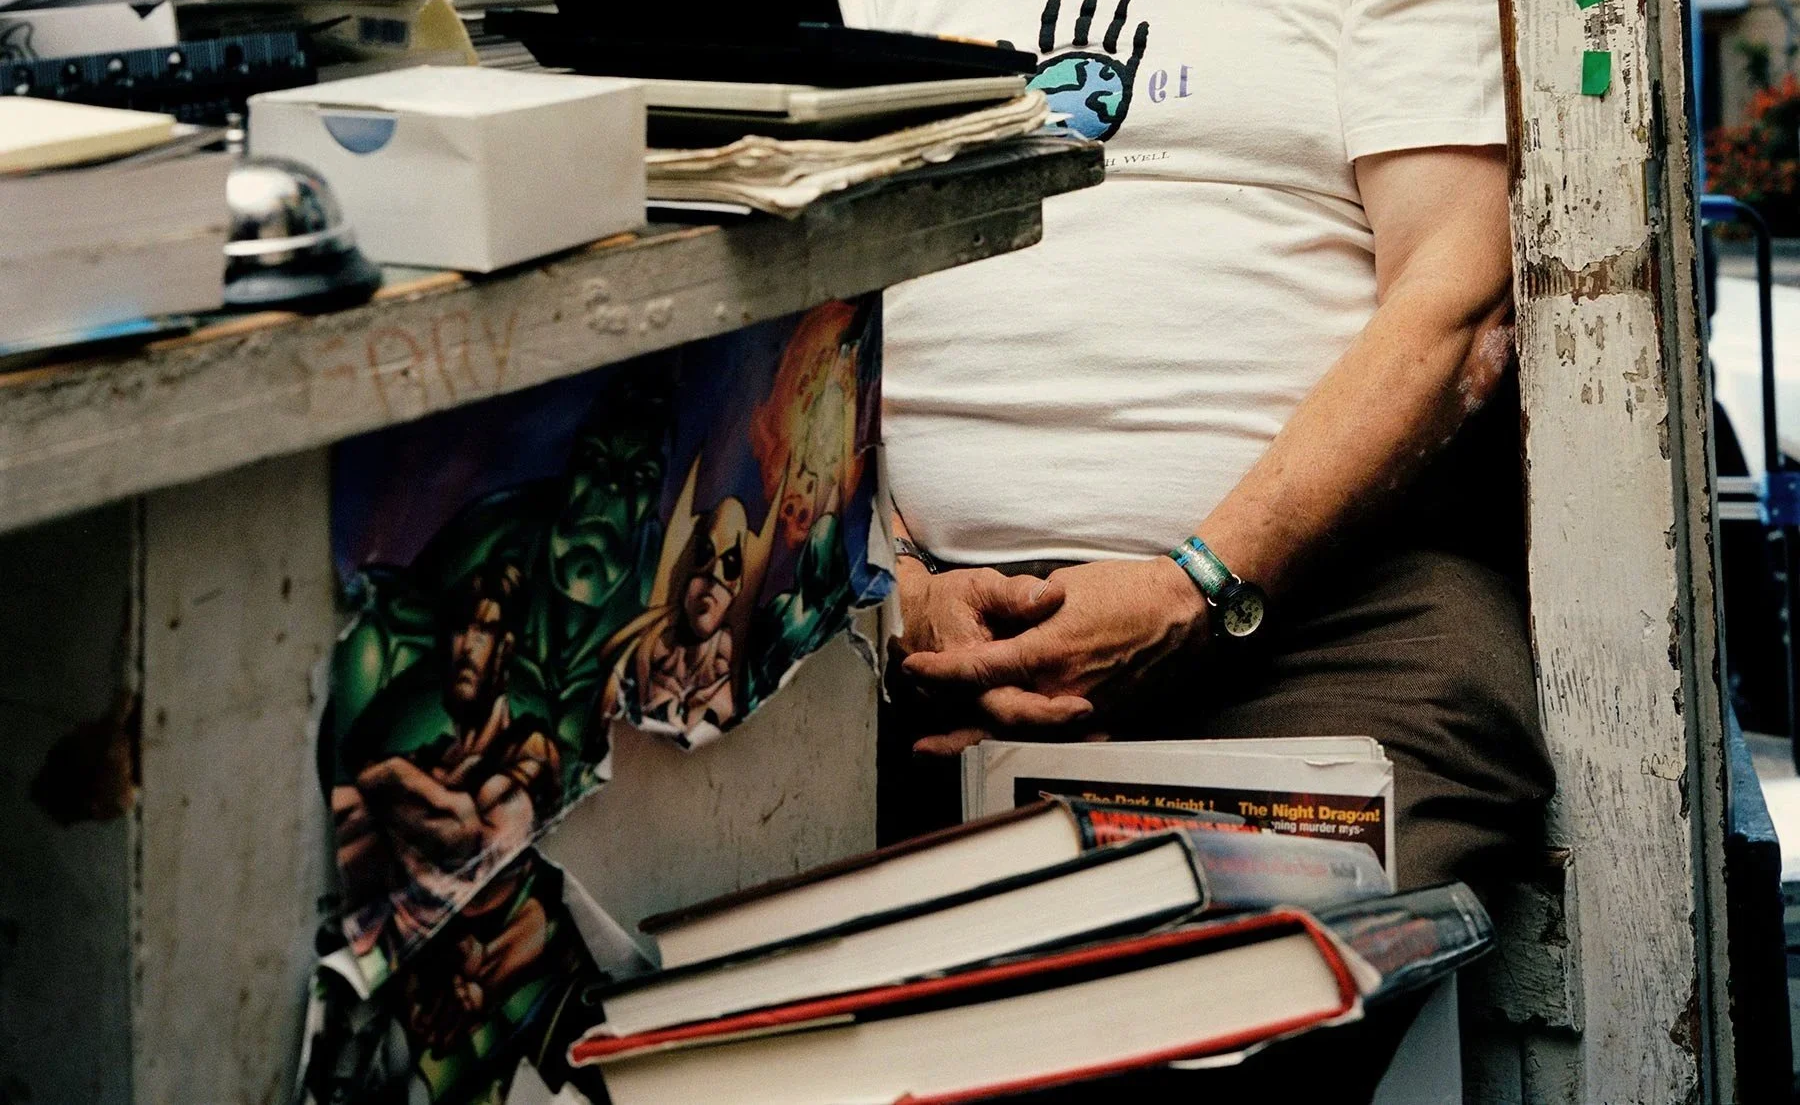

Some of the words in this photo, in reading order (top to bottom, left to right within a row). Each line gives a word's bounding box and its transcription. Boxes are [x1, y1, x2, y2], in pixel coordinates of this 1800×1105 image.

[1239, 801, 1268, 818] The
[1272, 803, 1315, 824] Night
[1318, 806, 1380, 827] Dragon!
[1299, 821, 1337, 834] murder
[1338, 823, 1365, 837] mys-
